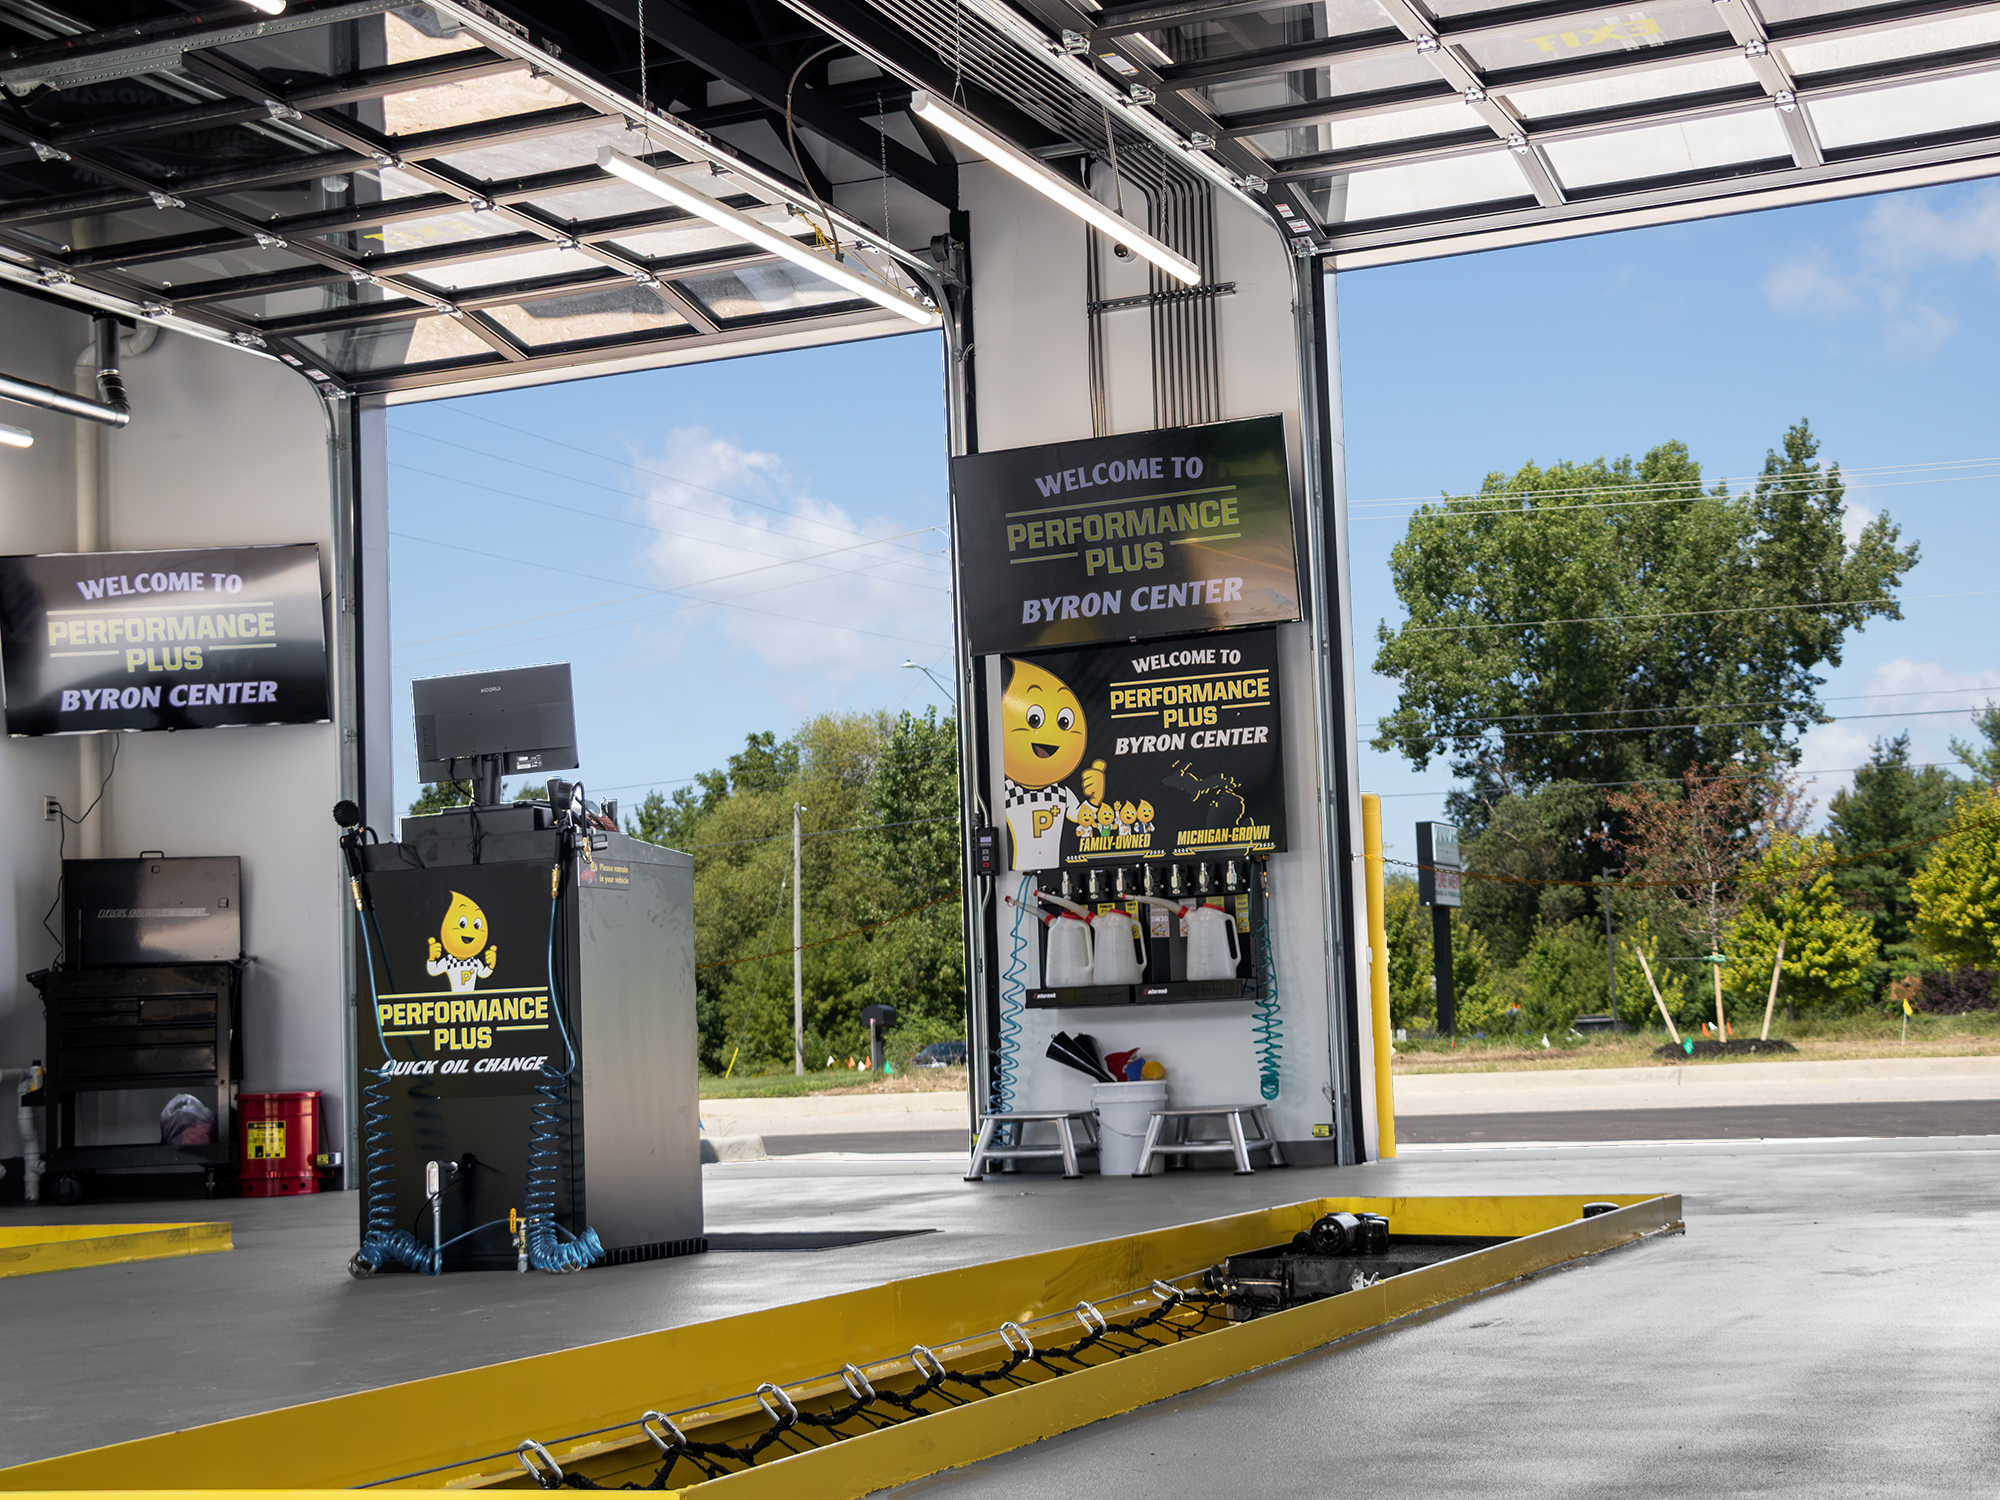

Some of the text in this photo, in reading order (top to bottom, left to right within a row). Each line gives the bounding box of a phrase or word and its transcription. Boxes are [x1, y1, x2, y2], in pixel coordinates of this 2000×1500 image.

[1035, 456, 1204, 498] WELCOME TO
[1007, 497, 1240, 552] PERFORMANCE
[1085, 541, 1165, 576] PLUS
[76, 571, 243, 600] WELCOME TO
[1022, 576, 1244, 625] BYRON CENTER
[47, 612, 276, 646] PERFORMANCE
[126, 646, 204, 673] PLUS
[1132, 649, 1241, 674] WELCOME TO
[60, 681, 278, 712] BYRON CENTER
[1110, 677, 1270, 710] PERFORMANCE
[1163, 706, 1218, 728] PLUS
[1115, 726, 1269, 755] BYRON CENTER
[1079, 834, 1151, 852] FAMILY-OWNED
[1177, 825, 1270, 846] MICHIGAN-GROWN
[600, 863, 628, 873] Please remain
[615, 876, 629, 884] vehicle
[378, 996, 549, 1026] PERFORMANCE
[434, 1026, 492, 1051] PLUS
[381, 1055, 549, 1077] QUICK OIL CHANGE
